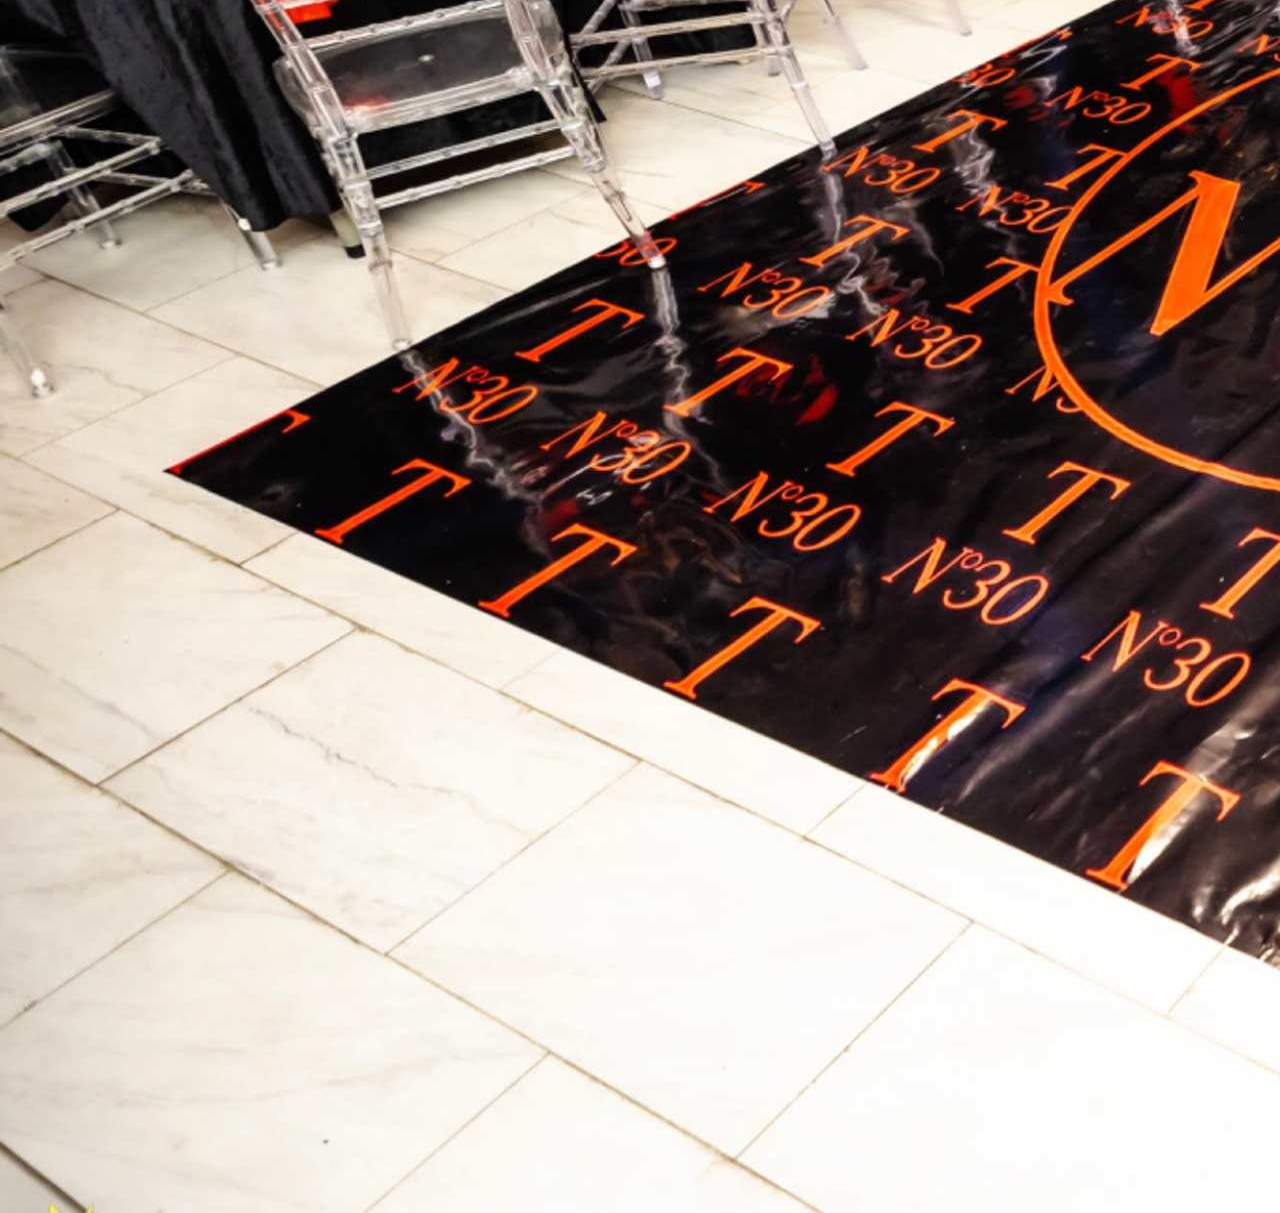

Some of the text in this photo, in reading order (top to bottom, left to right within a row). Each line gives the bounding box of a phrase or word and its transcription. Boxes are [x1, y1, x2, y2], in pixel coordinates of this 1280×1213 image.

[1120, 53, 1201, 91] T
[912, 109, 1007, 153] T
[1044, 143, 1130, 190] T
[799, 215, 910, 267] T
[946, 256, 1043, 313] T
[515, 298, 644, 362] T
[664, 347, 791, 416] T
[825, 402, 955, 476] T
[316, 458, 470, 544] T
[1003, 461, 1130, 545] T
[478, 523, 637, 616] T
[664, 596, 820, 698] T
[871, 678, 1025, 791] T
[1087, 760, 1239, 891] T
